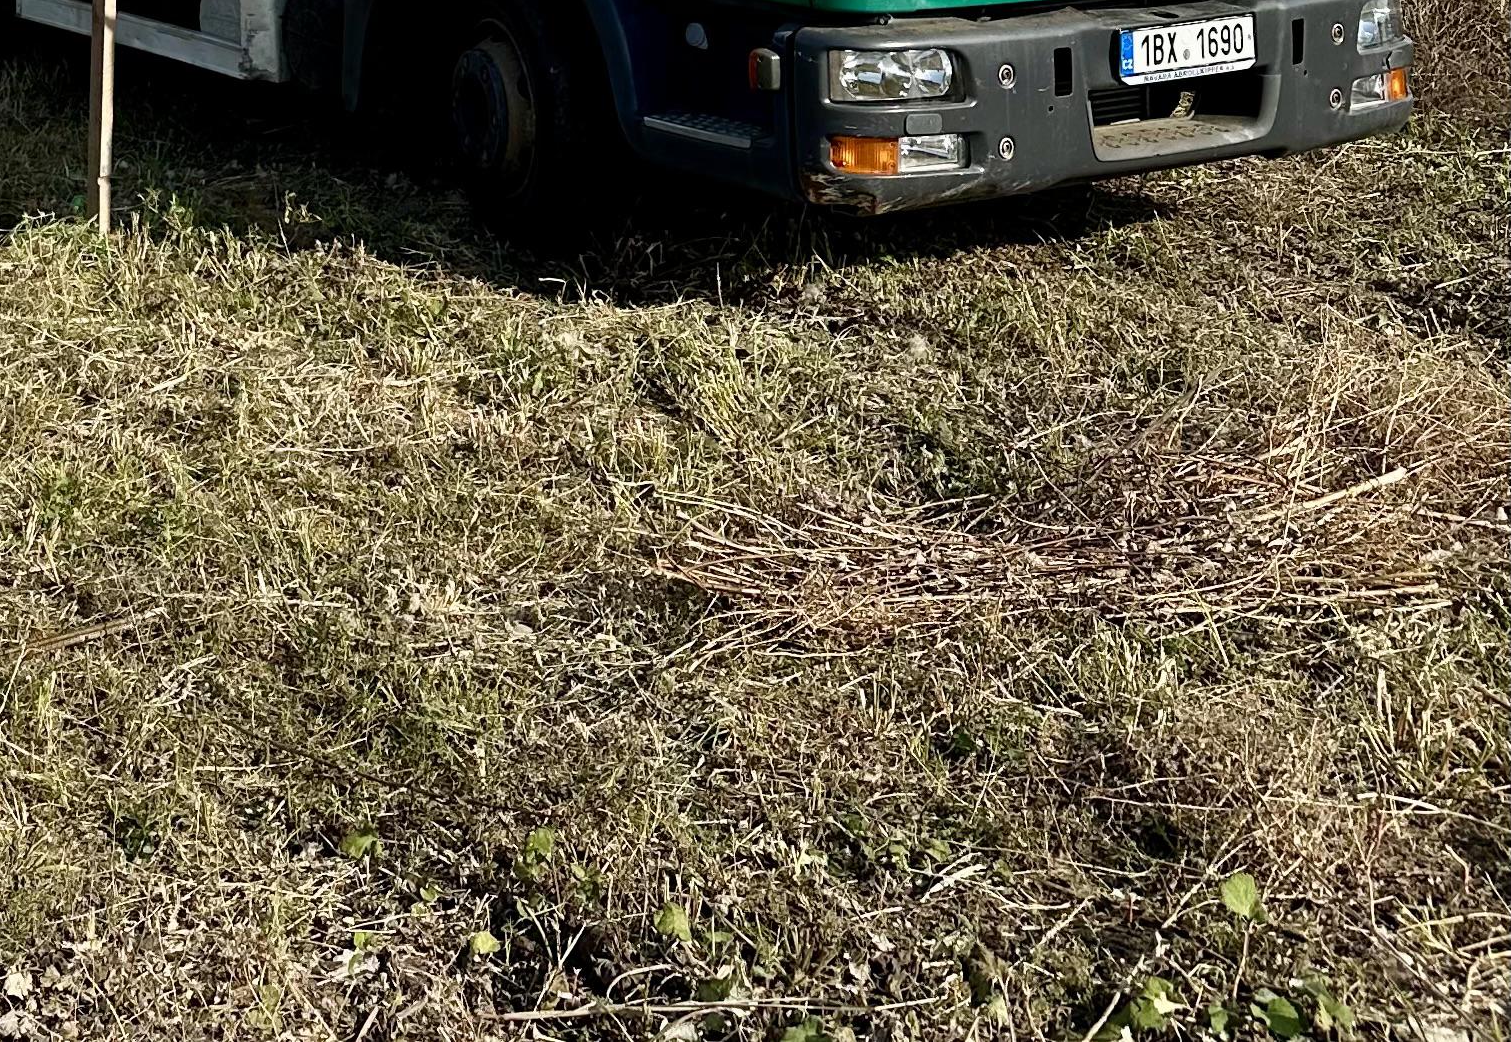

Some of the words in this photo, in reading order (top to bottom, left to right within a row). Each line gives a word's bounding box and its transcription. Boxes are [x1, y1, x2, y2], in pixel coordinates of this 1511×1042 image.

[1140, 31, 1178, 67] 1BX
[1196, 23, 1244, 59] 1690
[1121, 58, 1134, 70] CZ
